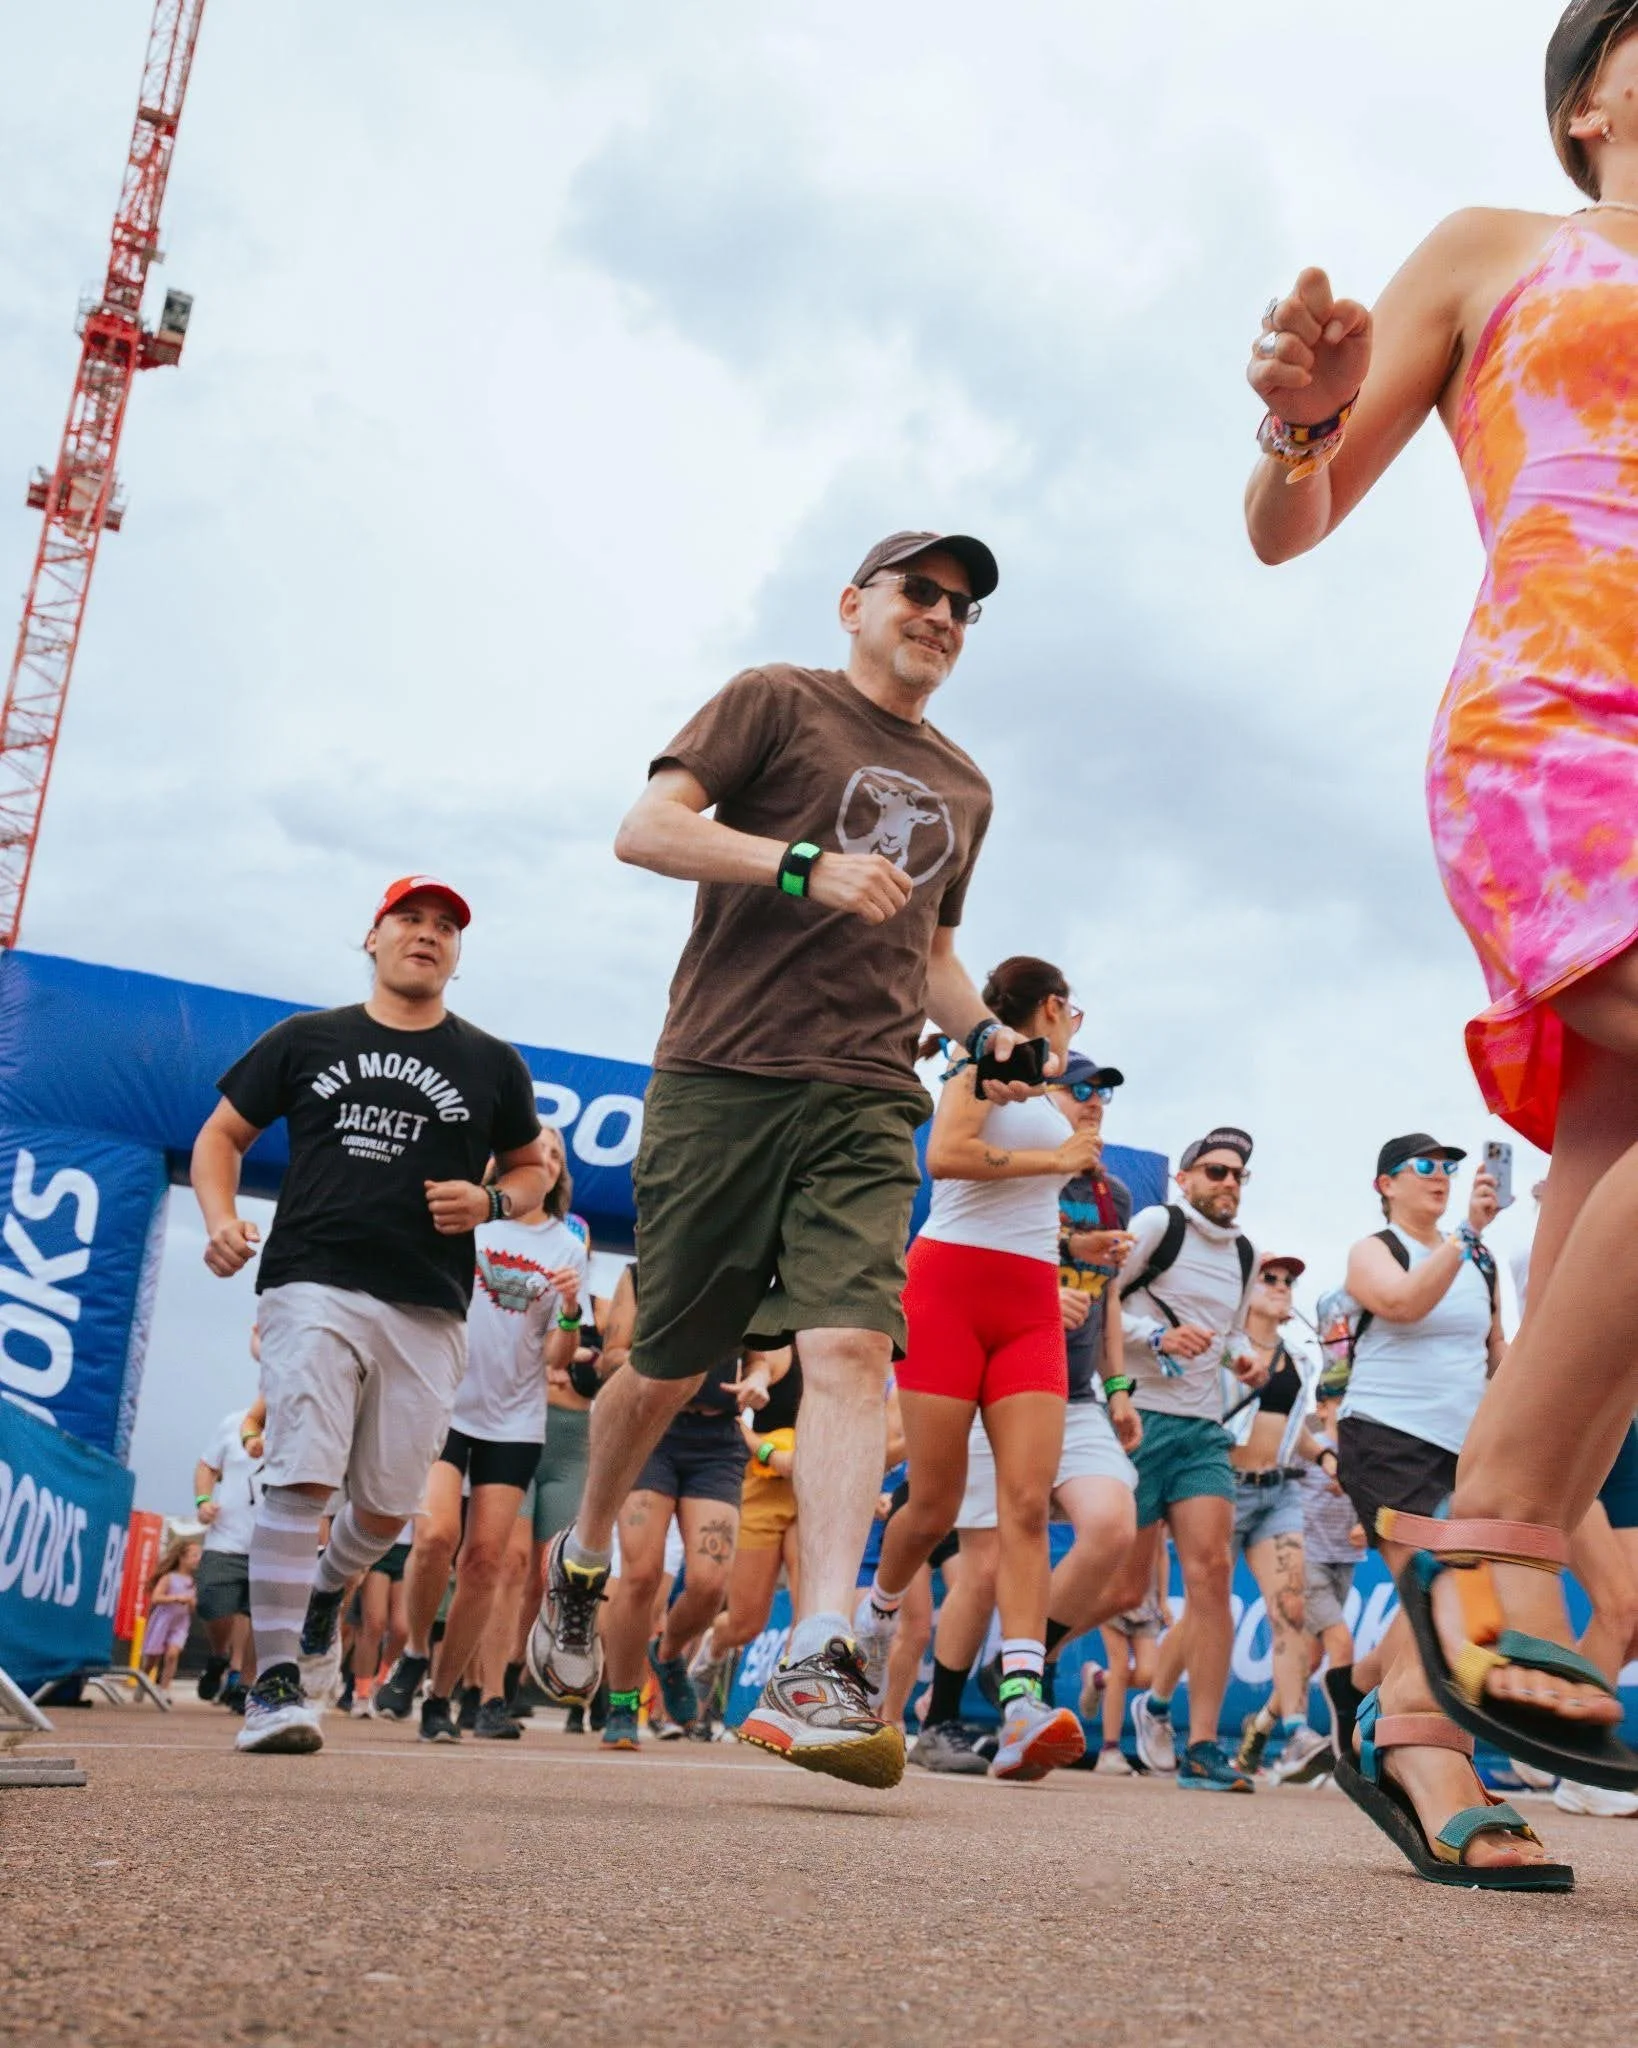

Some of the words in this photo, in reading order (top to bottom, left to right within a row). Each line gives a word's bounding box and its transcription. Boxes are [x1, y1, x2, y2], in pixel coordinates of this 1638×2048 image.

[311, 1059, 352, 1100] MY
[357, 1052, 470, 1123] MORNING
[333, 1102, 429, 1142] JACKET
[0, 1148, 99, 1427] OKS
